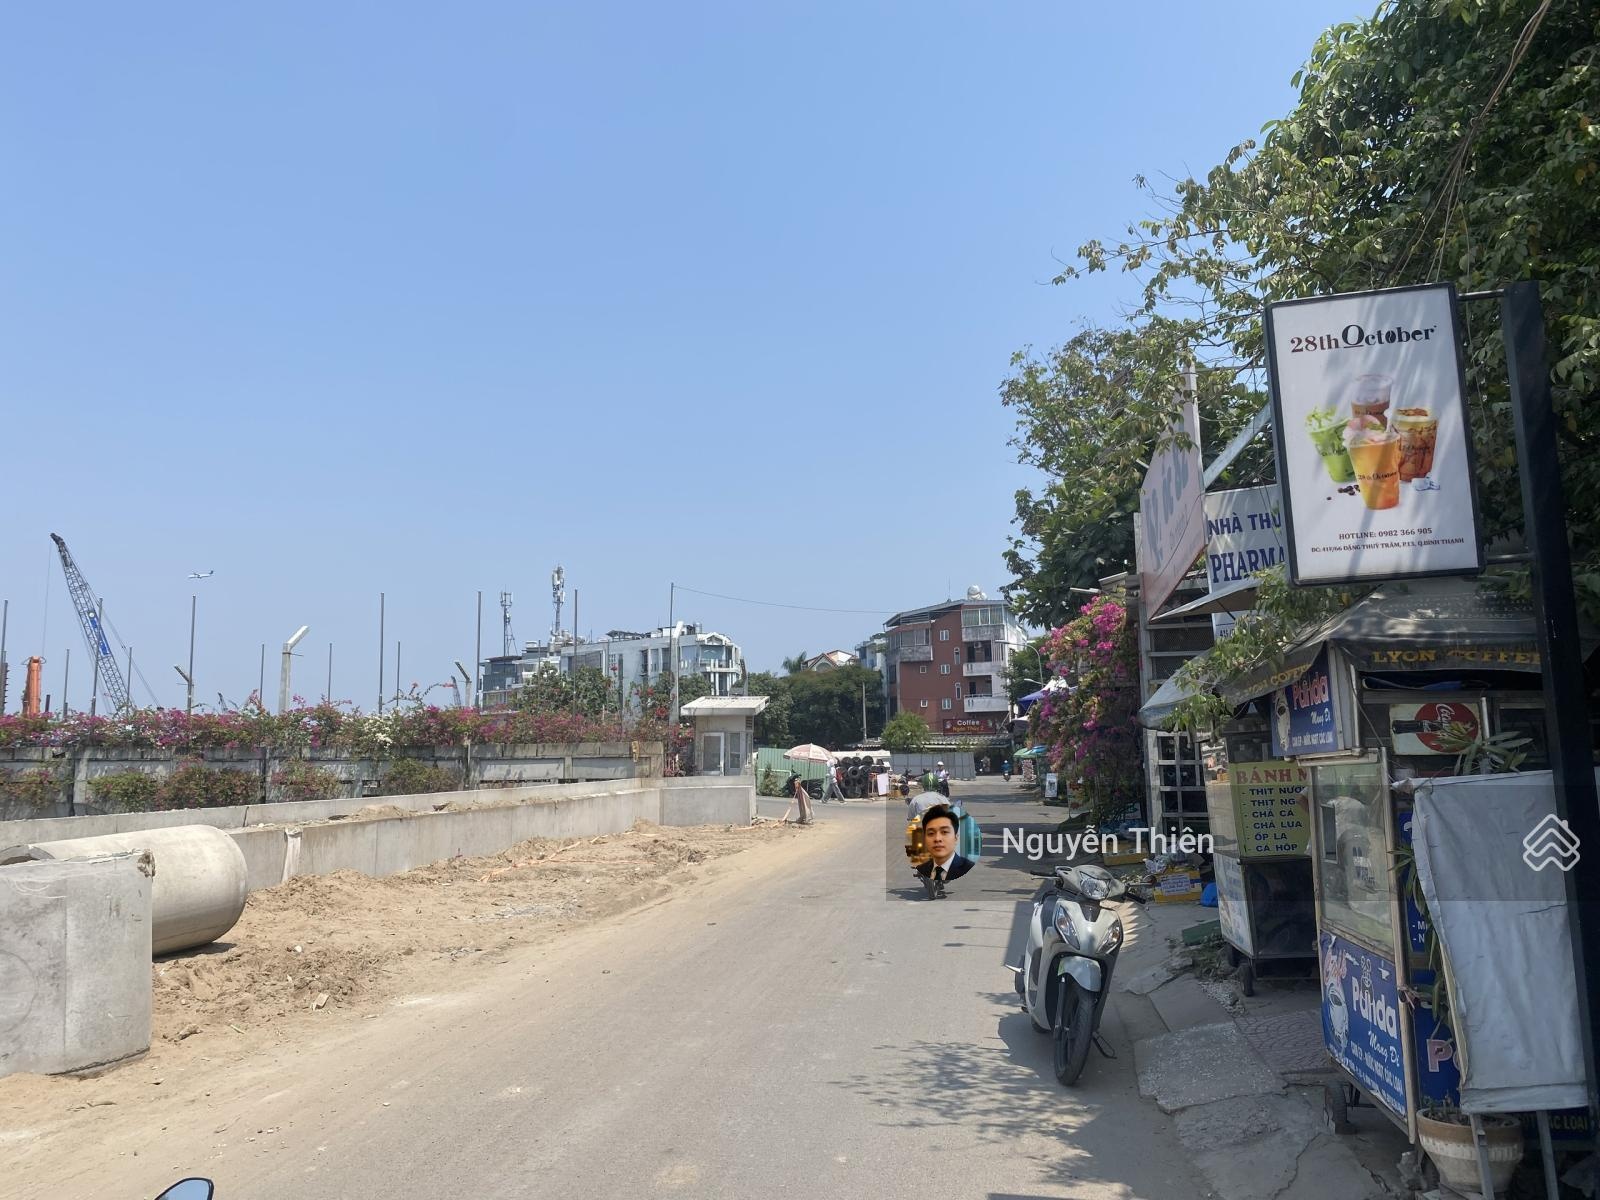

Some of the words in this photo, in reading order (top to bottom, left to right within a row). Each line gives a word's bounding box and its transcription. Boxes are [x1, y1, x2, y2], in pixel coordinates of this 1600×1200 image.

[1290, 335, 1339, 353] 28th
[1207, 512, 1243, 536] NHÀ
[1338, 531, 1376, 540] HOTLINE:
[1372, 650, 1437, 663] LYON
[1235, 766, 1293, 785] BÁNH
[1352, 975, 1397, 1039] Panda
